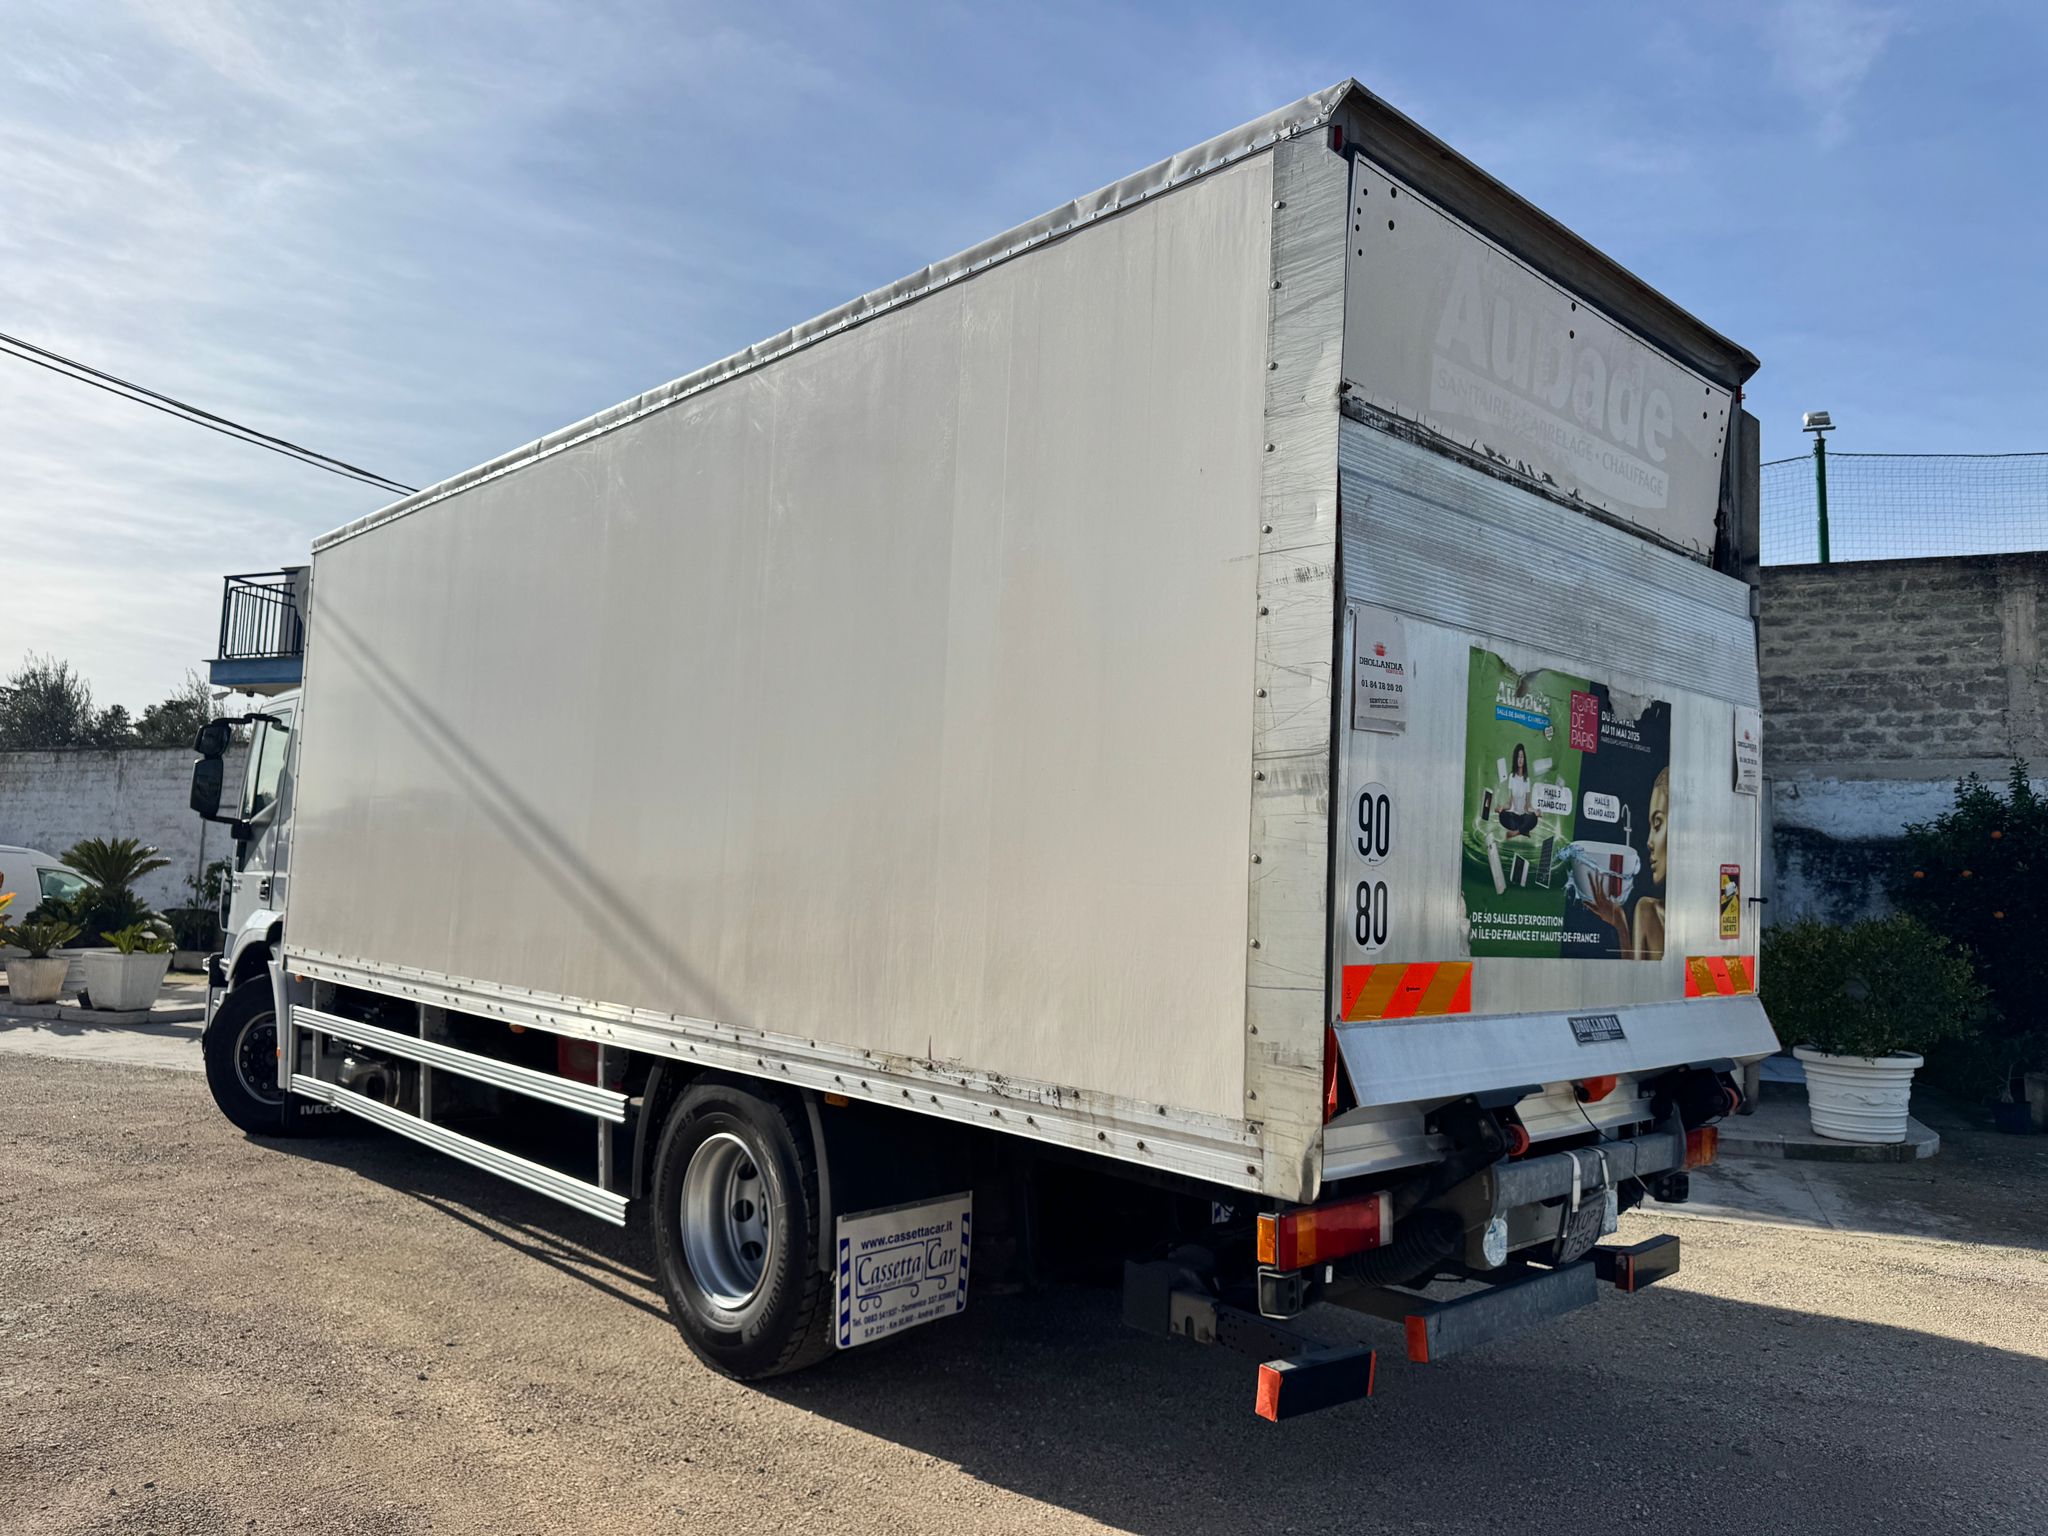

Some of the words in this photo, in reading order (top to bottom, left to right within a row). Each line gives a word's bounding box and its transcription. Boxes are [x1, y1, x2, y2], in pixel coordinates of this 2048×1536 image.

[1434, 253, 1674, 463] Aubade
[1602, 451, 1665, 498] CHAUFFAGE
[1359, 656, 1404, 672] DHOLLANDIA
[1361, 679, 1368, 688] 01
[1571, 711, 1584, 730] DE
[1601, 711, 1611, 722] DU
[1571, 729, 1594, 749] PARIS
[1601, 723, 1610, 735] AU
[1610, 726, 1616, 737] 11
[1615, 727, 1627, 739] MAI
[1543, 787, 1557, 798] HALL
[1537, 799, 1555, 809] STAND
[1594, 796, 1606, 806] HALL
[1587, 807, 1603, 817] STAND
[1358, 792, 1390, 857] 90
[1355, 880, 1388, 946] 80
[1472, 911, 1483, 923] DE
[1492, 913, 1517, 925] SALLES
[1518, 914, 1564, 927] D'EXPOSITION
[1531, 930, 1540, 941] ET
[300, 1104, 341, 1116] IVECO
[860, 1220, 953, 1250] www.cassettacar.it
[858, 1255, 922, 1286] Cassetta
[928, 1241, 957, 1271] Car
